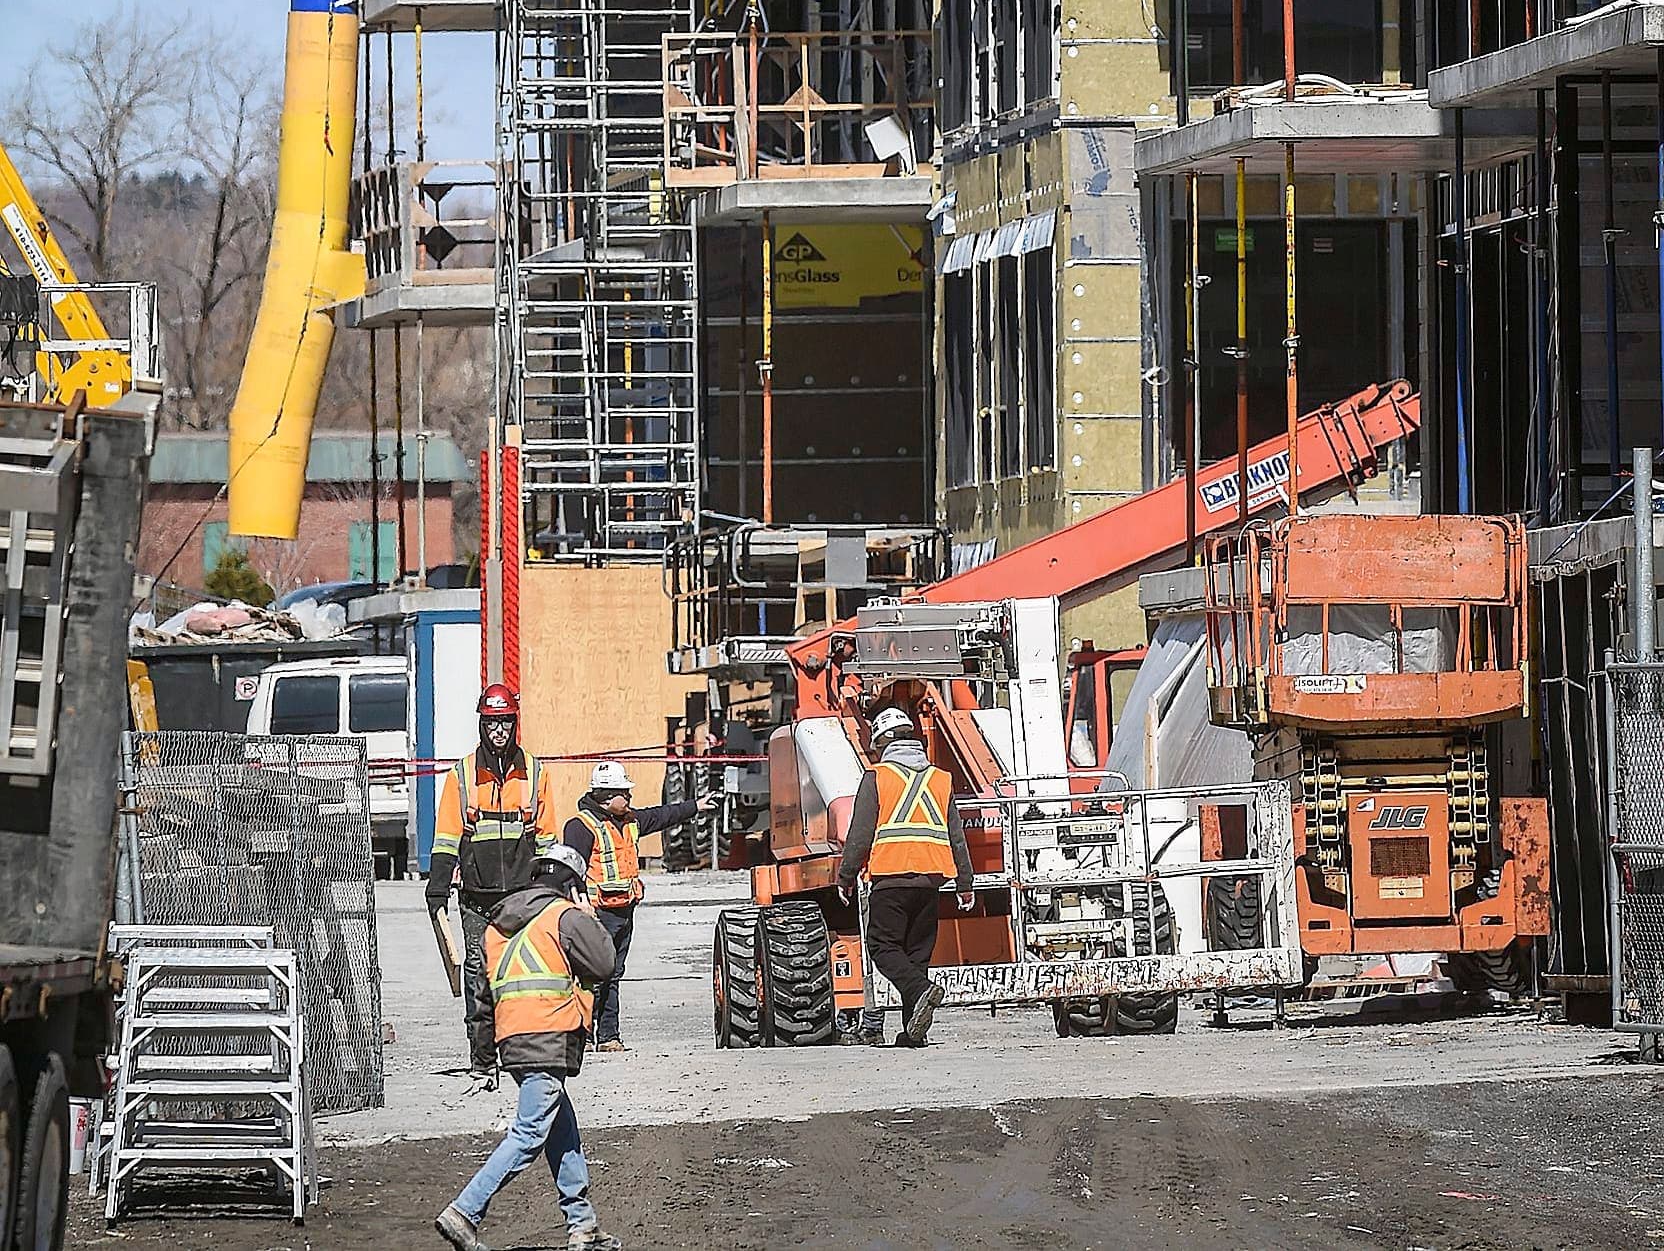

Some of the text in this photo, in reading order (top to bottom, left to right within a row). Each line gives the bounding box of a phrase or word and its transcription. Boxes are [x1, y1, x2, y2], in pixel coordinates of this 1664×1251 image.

[783, 244, 813, 261] GP
[1298, 679, 1334, 687] ISOLIFT
[961, 816, 1002, 829] ANUL
[1369, 807, 1428, 830] JLG
